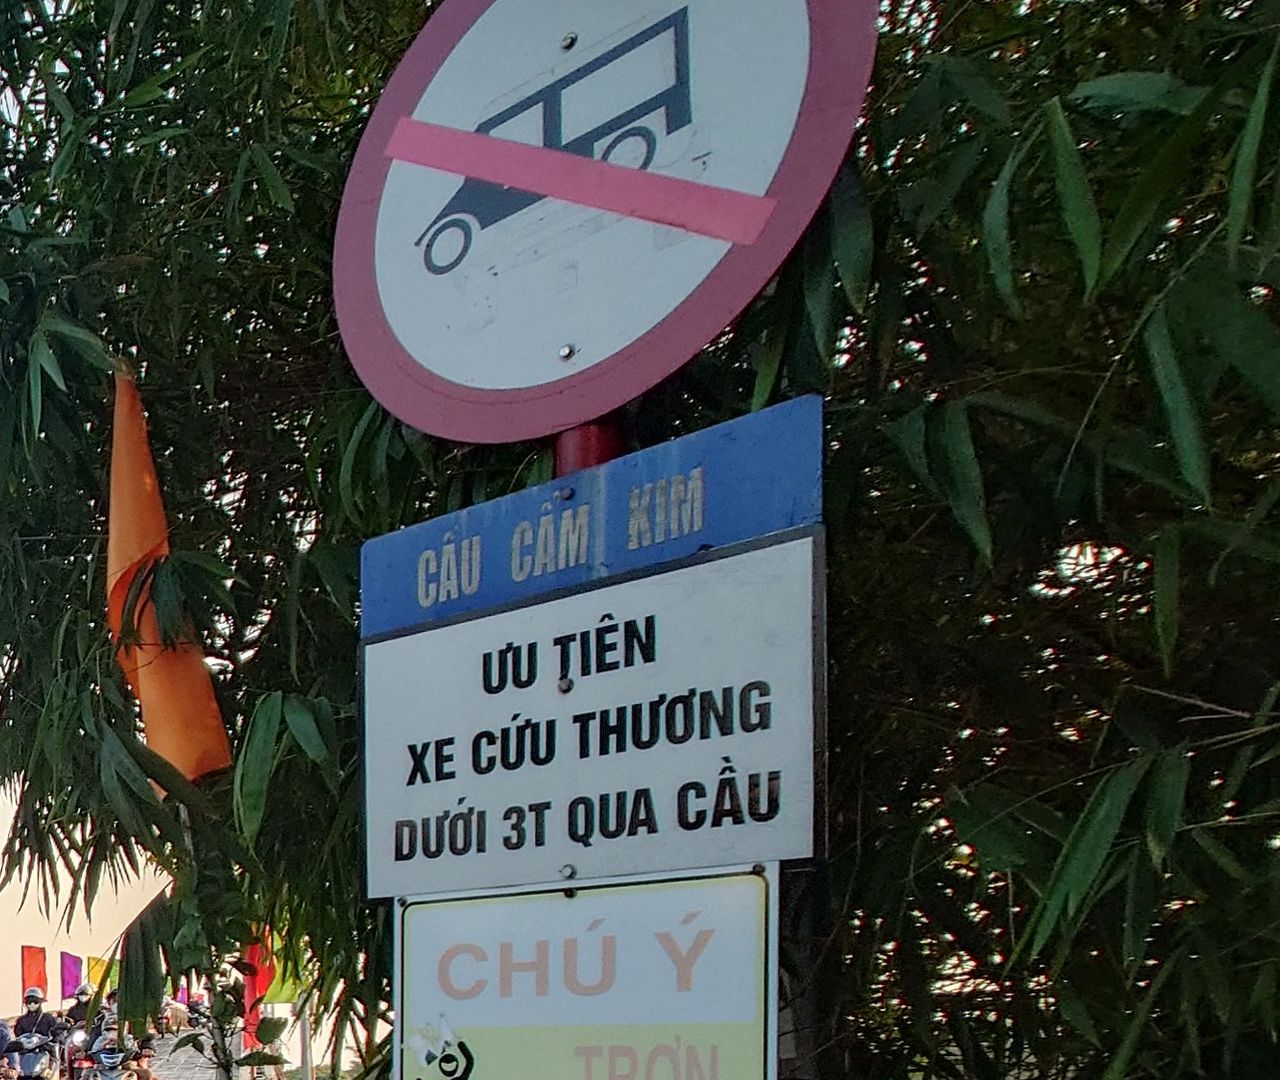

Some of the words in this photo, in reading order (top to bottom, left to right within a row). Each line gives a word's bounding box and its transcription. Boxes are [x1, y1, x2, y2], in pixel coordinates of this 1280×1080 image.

[627, 467, 704, 551] KIM
[482, 641, 538, 695] ƯU
[552, 612, 656, 684] TIÊN
[406, 736, 456, 786] XE
[471, 713, 557, 774] CỨU
[572, 680, 772, 760] THƯƠNG
[394, 798, 486, 862] DƯỚI
[503, 801, 552, 850] 3T
[567, 787, 658, 848] QUA
[677, 756, 782, 832] CẦU
[437, 918, 617, 1001] CHÚ
[654, 910, 716, 993] Ý
